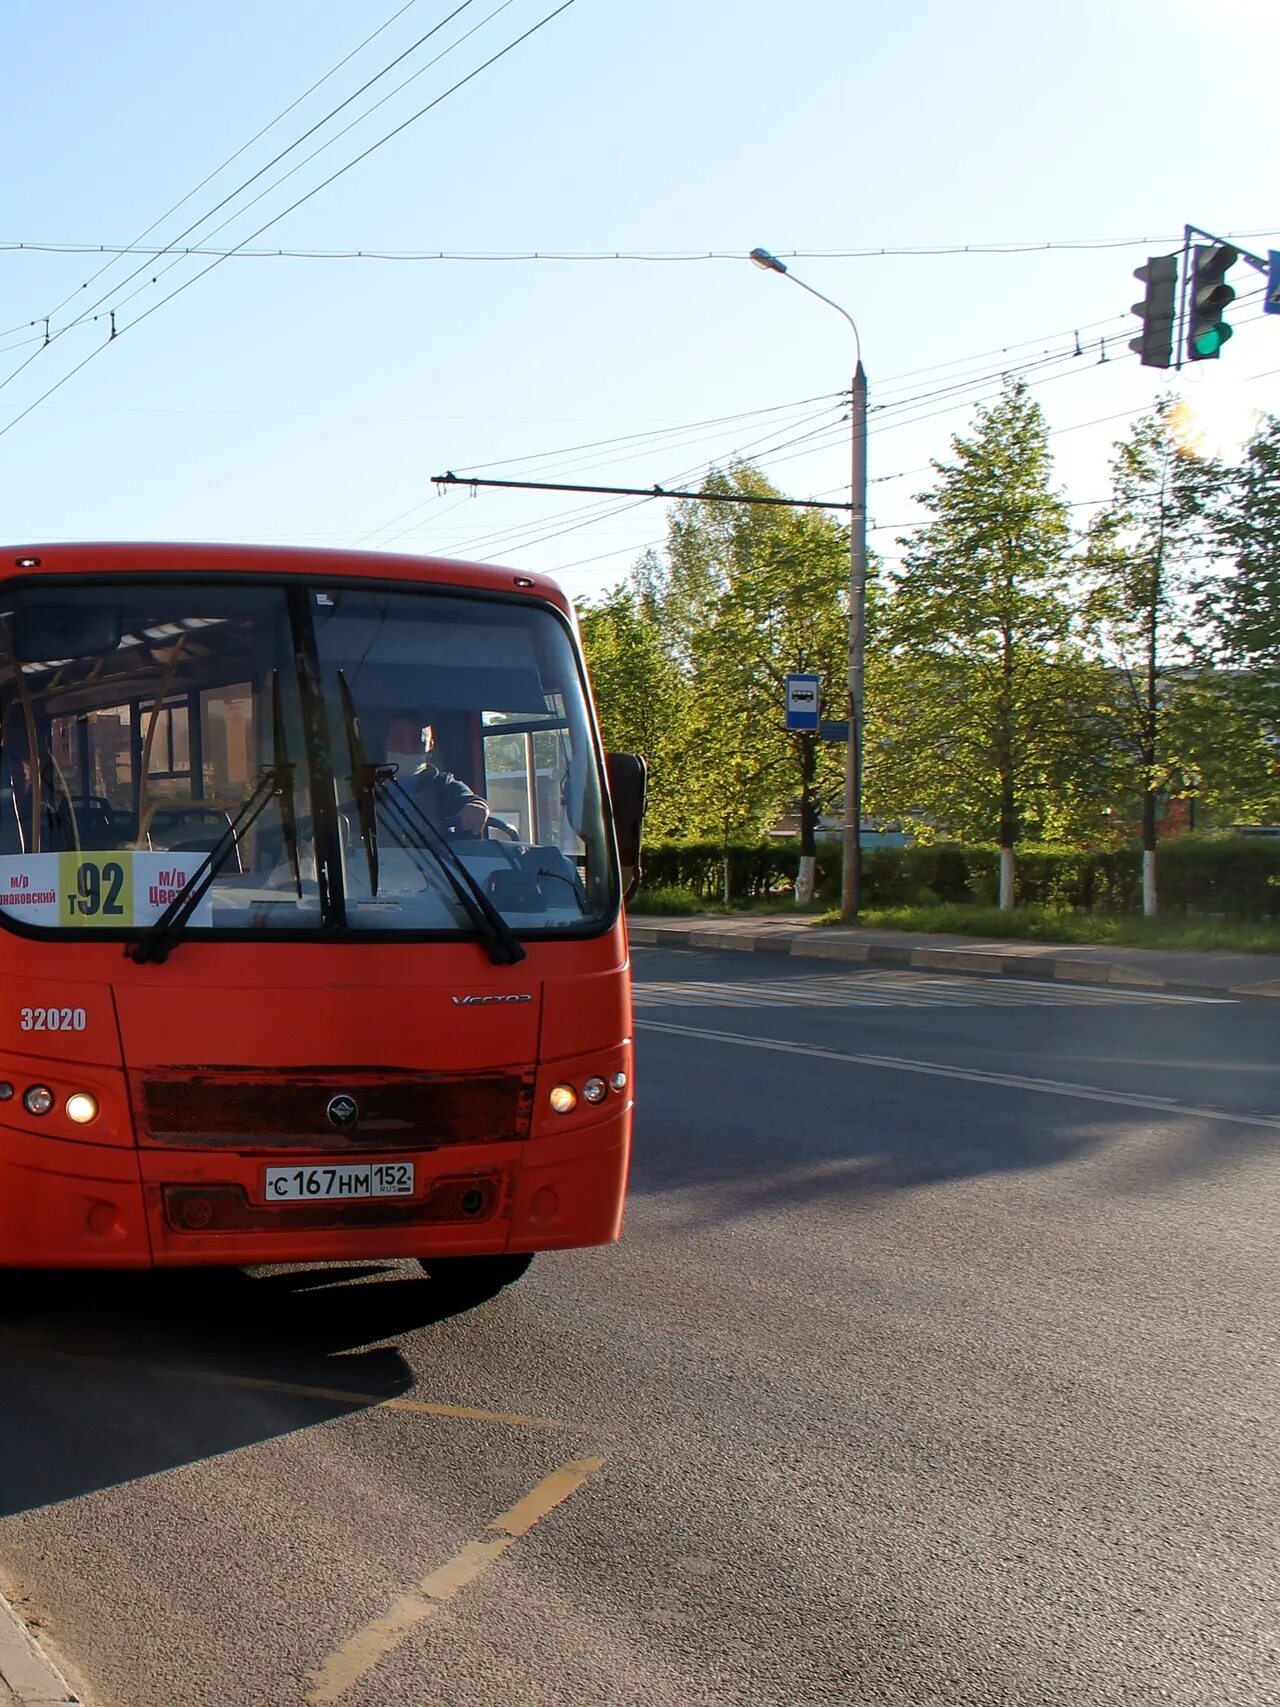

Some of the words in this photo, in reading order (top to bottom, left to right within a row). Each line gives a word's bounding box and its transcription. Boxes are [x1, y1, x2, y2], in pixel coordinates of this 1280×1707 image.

[20, 1008, 86, 1031] 32020
[374, 1166, 408, 1186] 152
[379, 1185, 398, 1193] RUS
